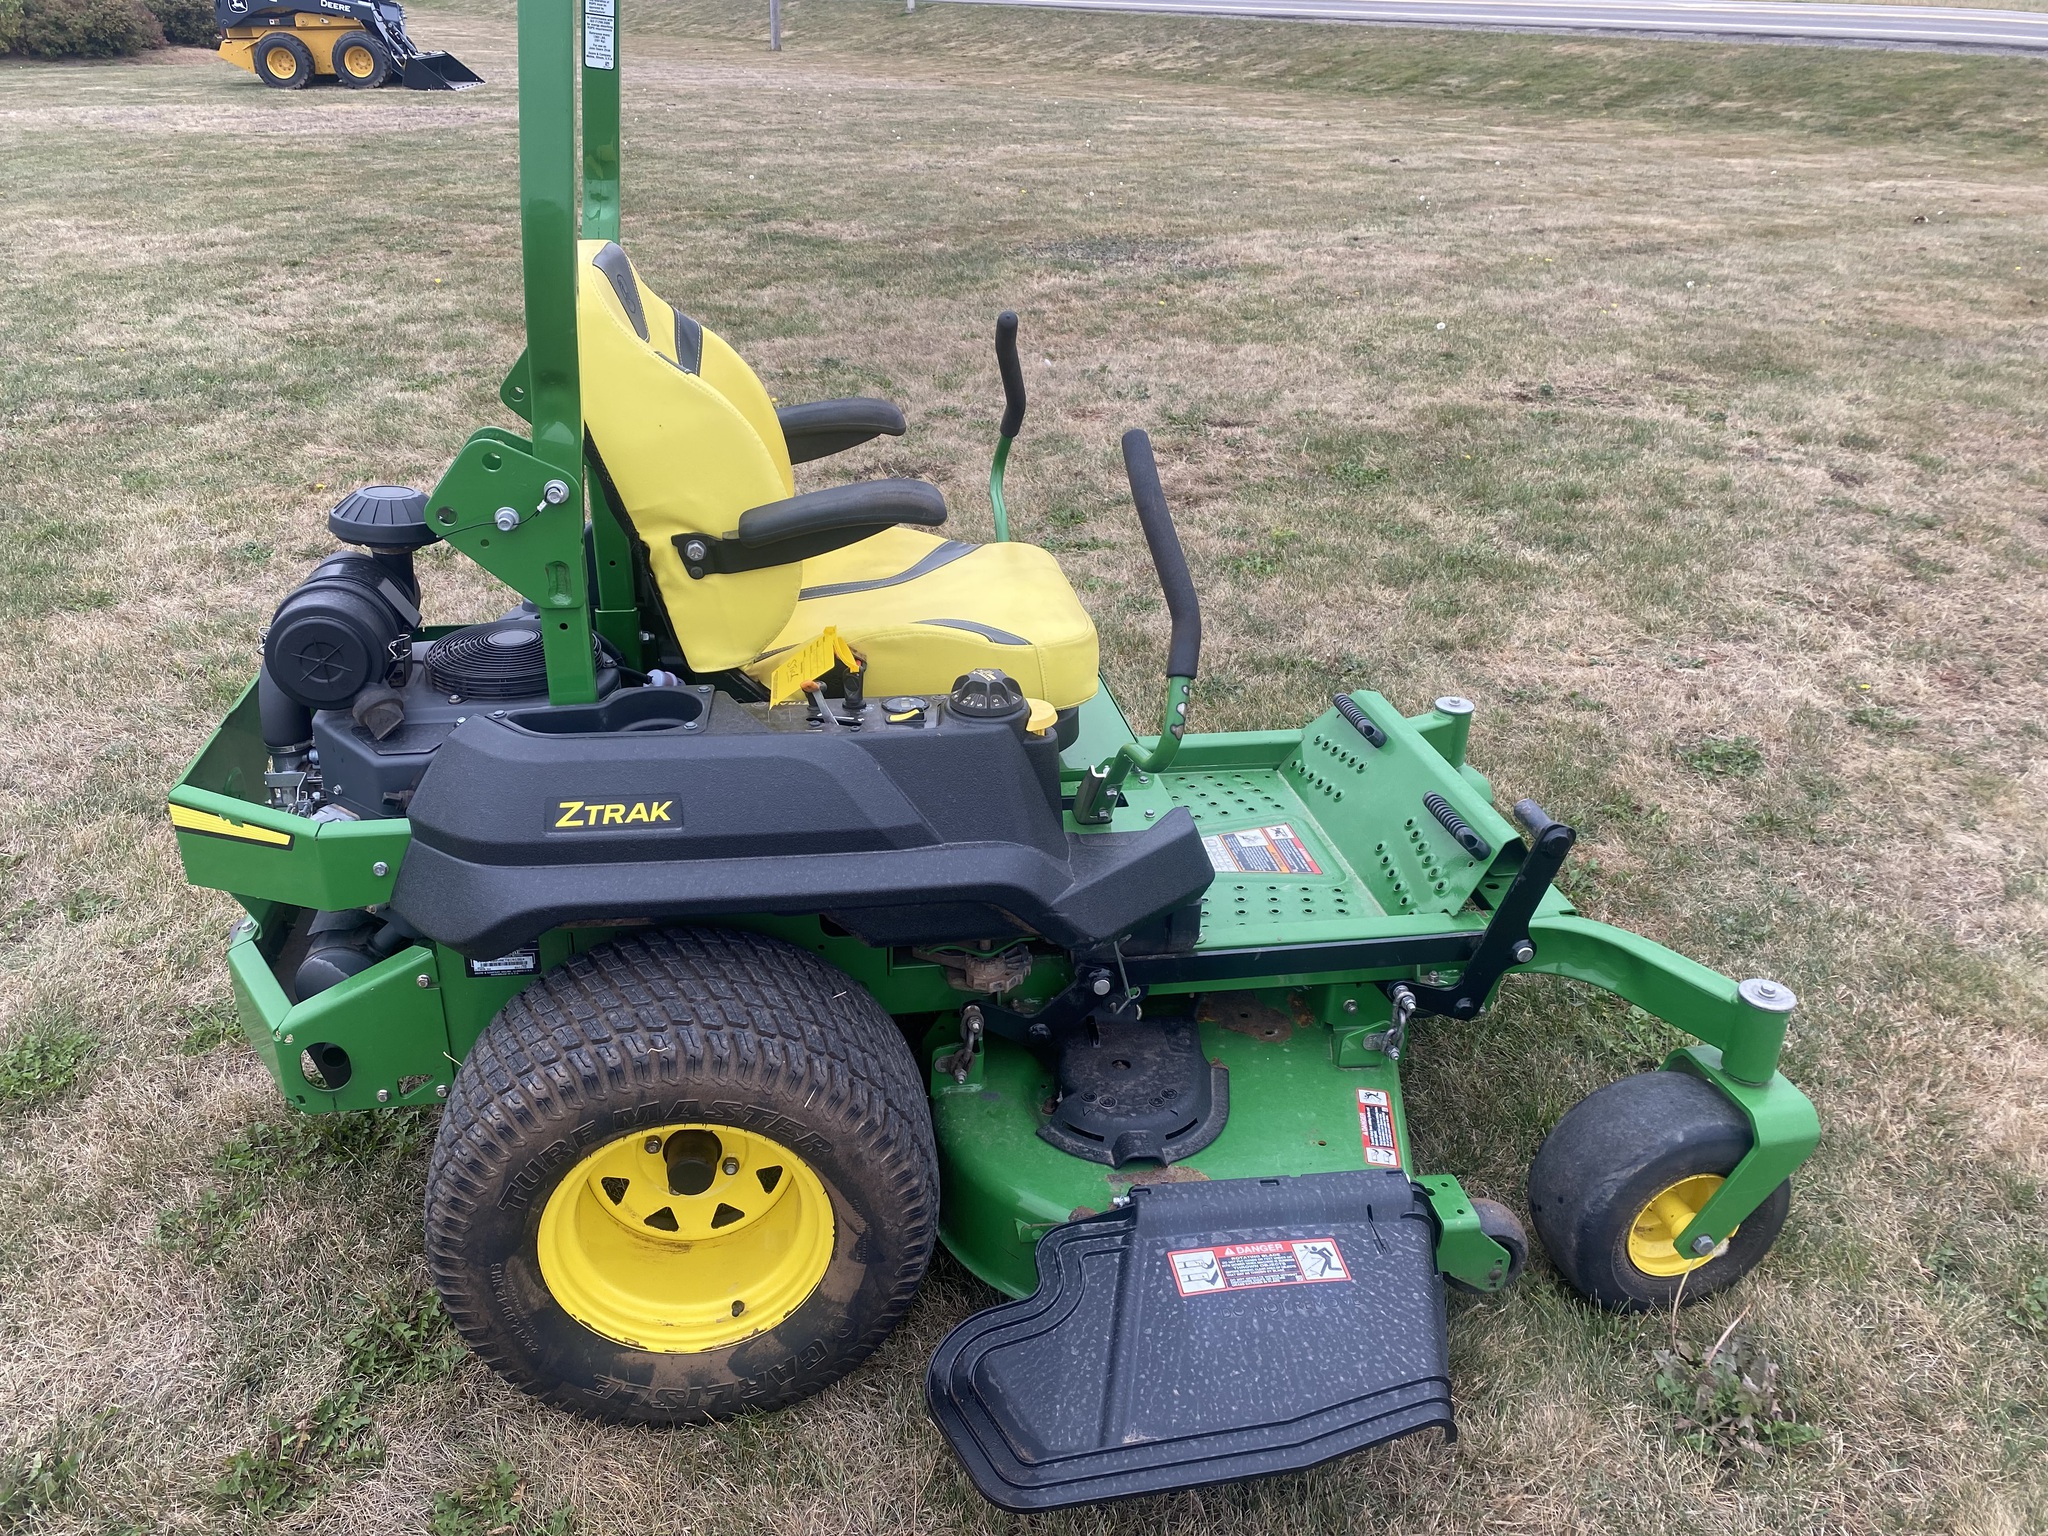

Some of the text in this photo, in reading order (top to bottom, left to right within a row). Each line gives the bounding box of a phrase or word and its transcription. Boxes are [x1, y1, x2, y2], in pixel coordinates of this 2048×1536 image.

[320, 0, 351, 12] DEERE
[555, 801, 673, 827] ZTRAK
[498, 1099, 833, 1211] TURF MASTER
[1236, 1244, 1283, 1254] DANGER
[1221, 1306, 1245, 1318] DO
[582, 1338, 829, 1409] CARLISLE
